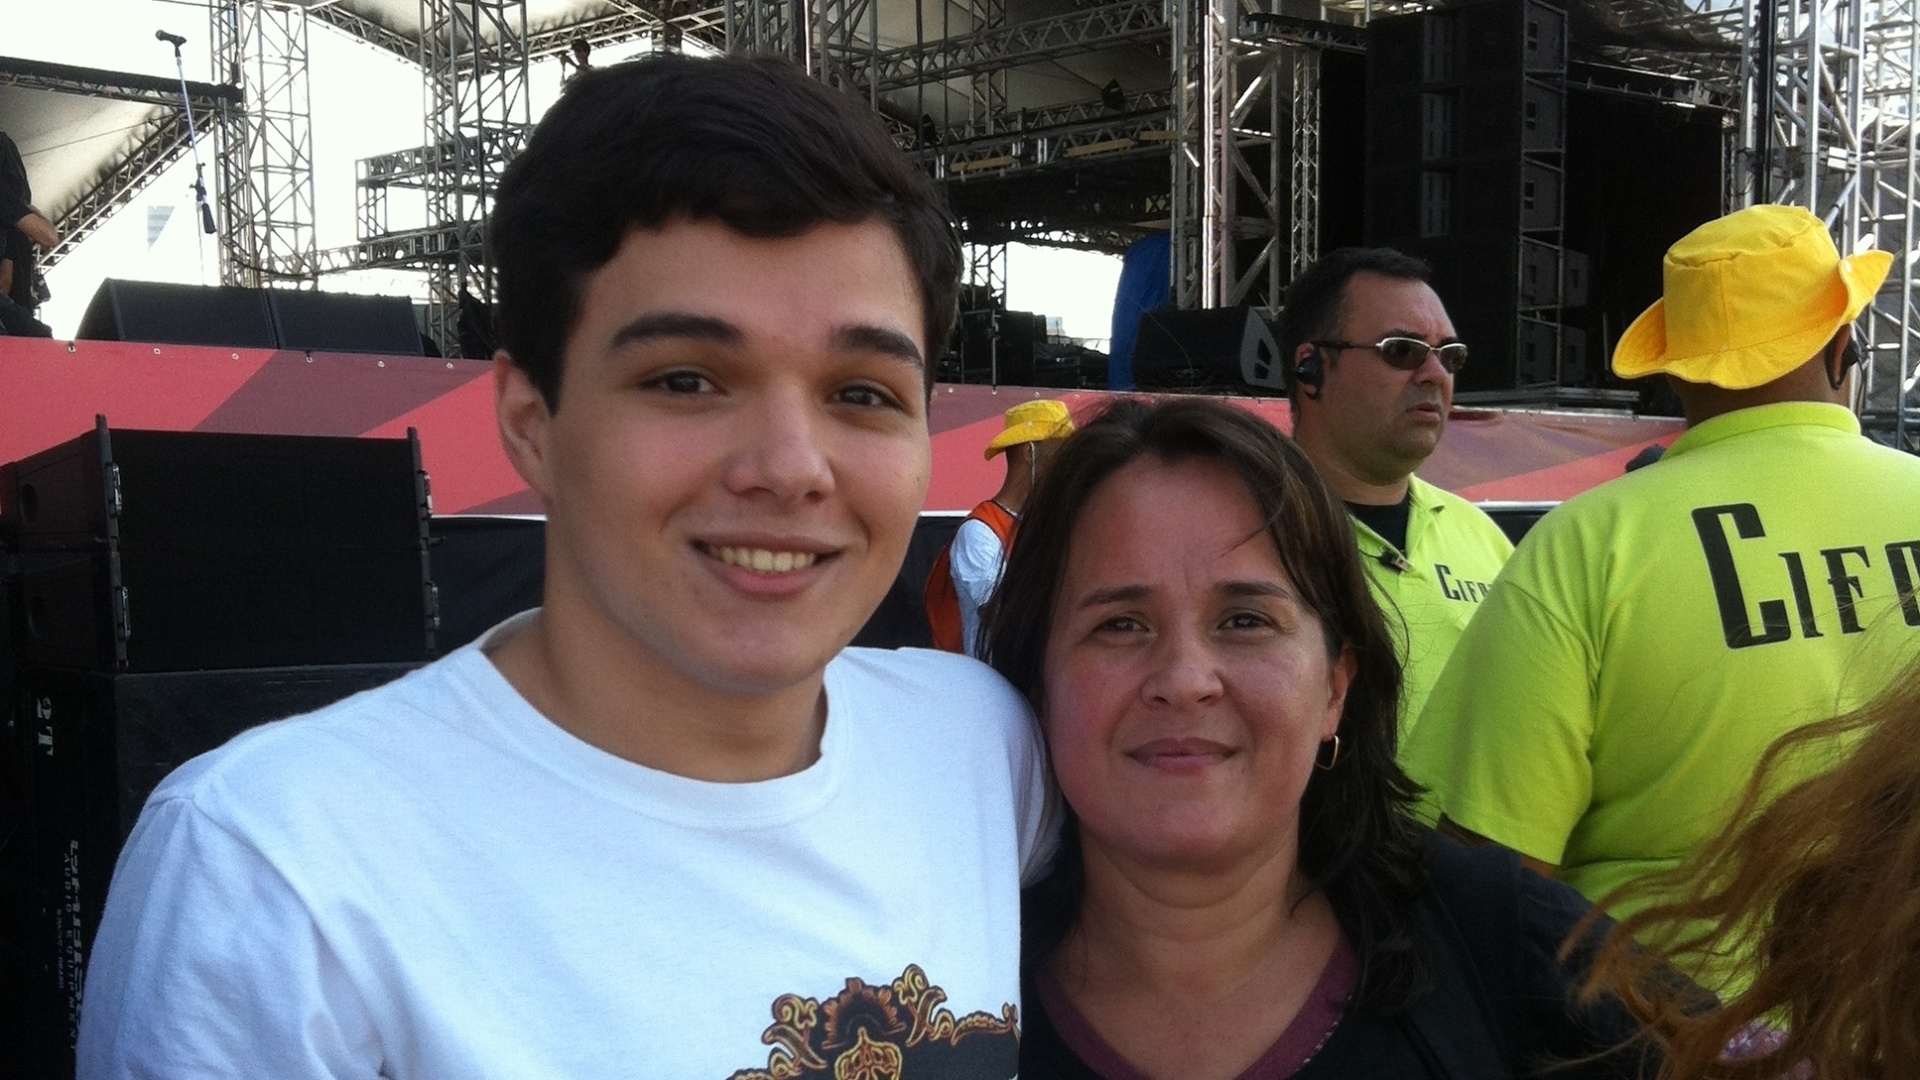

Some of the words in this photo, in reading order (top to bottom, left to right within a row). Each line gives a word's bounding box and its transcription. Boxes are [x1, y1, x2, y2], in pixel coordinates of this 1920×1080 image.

[1434, 564, 1491, 603] CIFO
[64, 853, 72, 913] AUDIO
[67, 929, 76, 1050] EQUIPMENT
